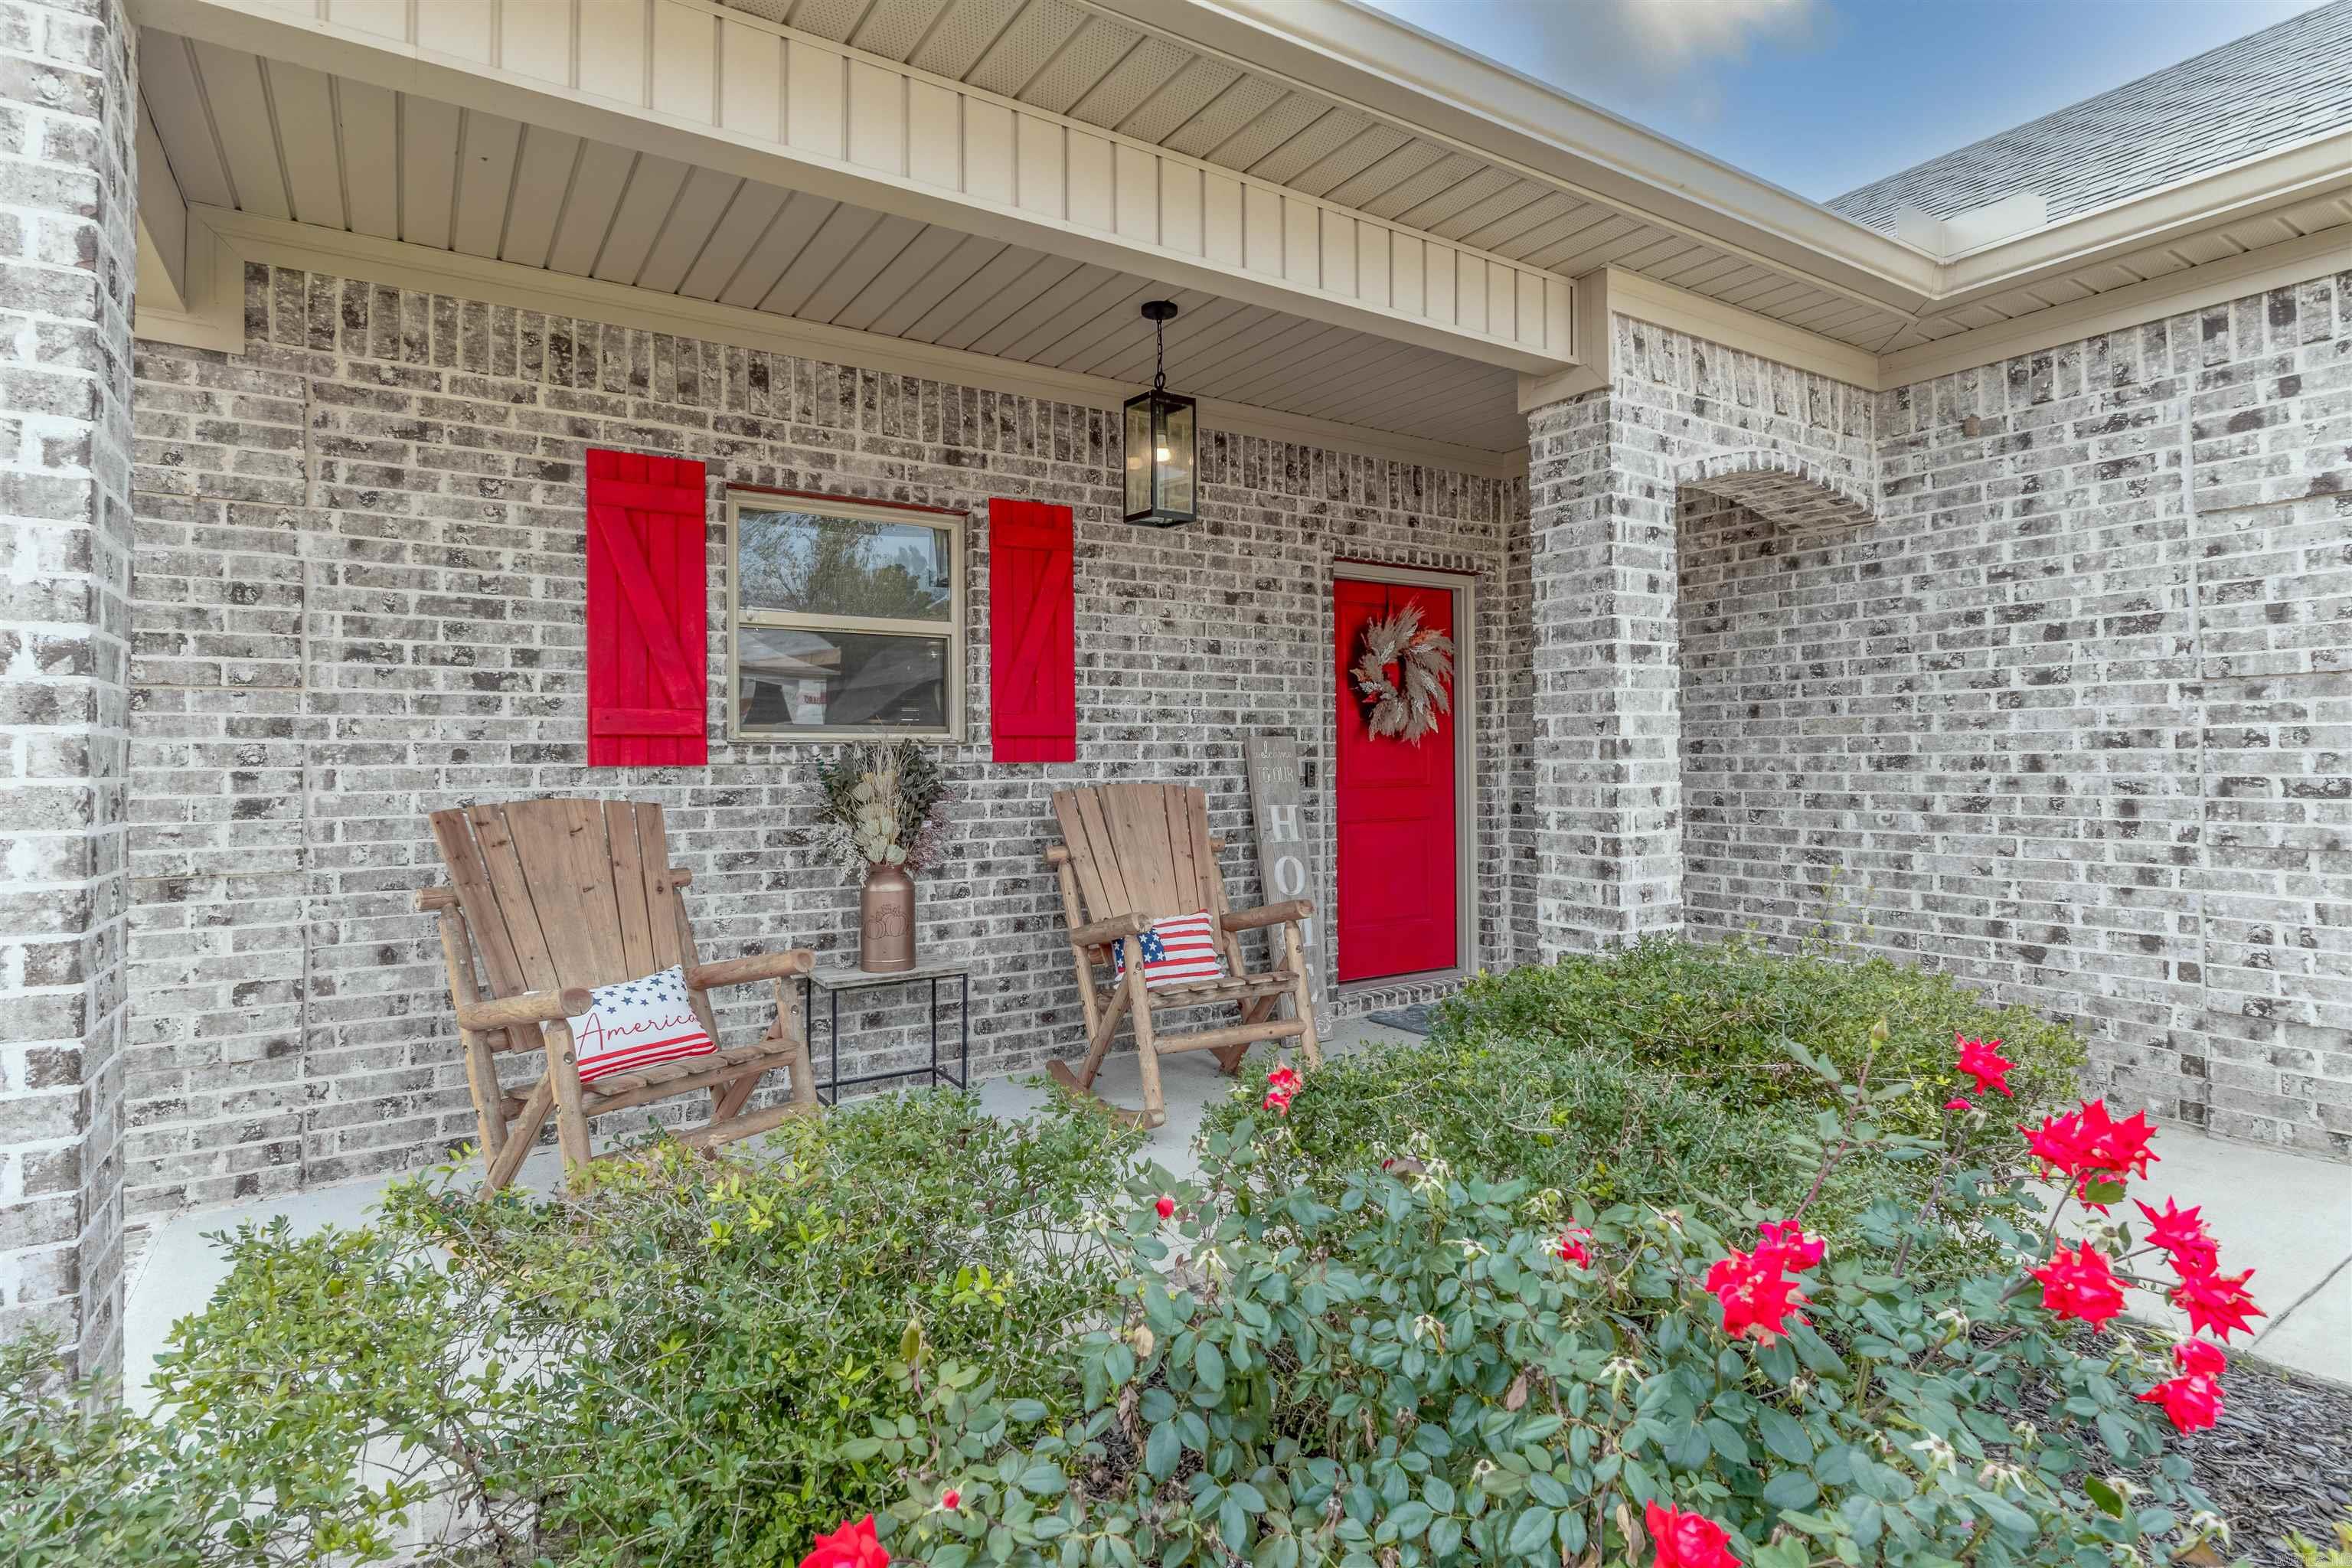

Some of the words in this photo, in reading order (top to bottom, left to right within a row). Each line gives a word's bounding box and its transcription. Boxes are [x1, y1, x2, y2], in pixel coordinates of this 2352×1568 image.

[1256, 766, 1270, 782] TO
[1272, 766, 1294, 782] OUR
[576, 1012, 697, 1057] America
